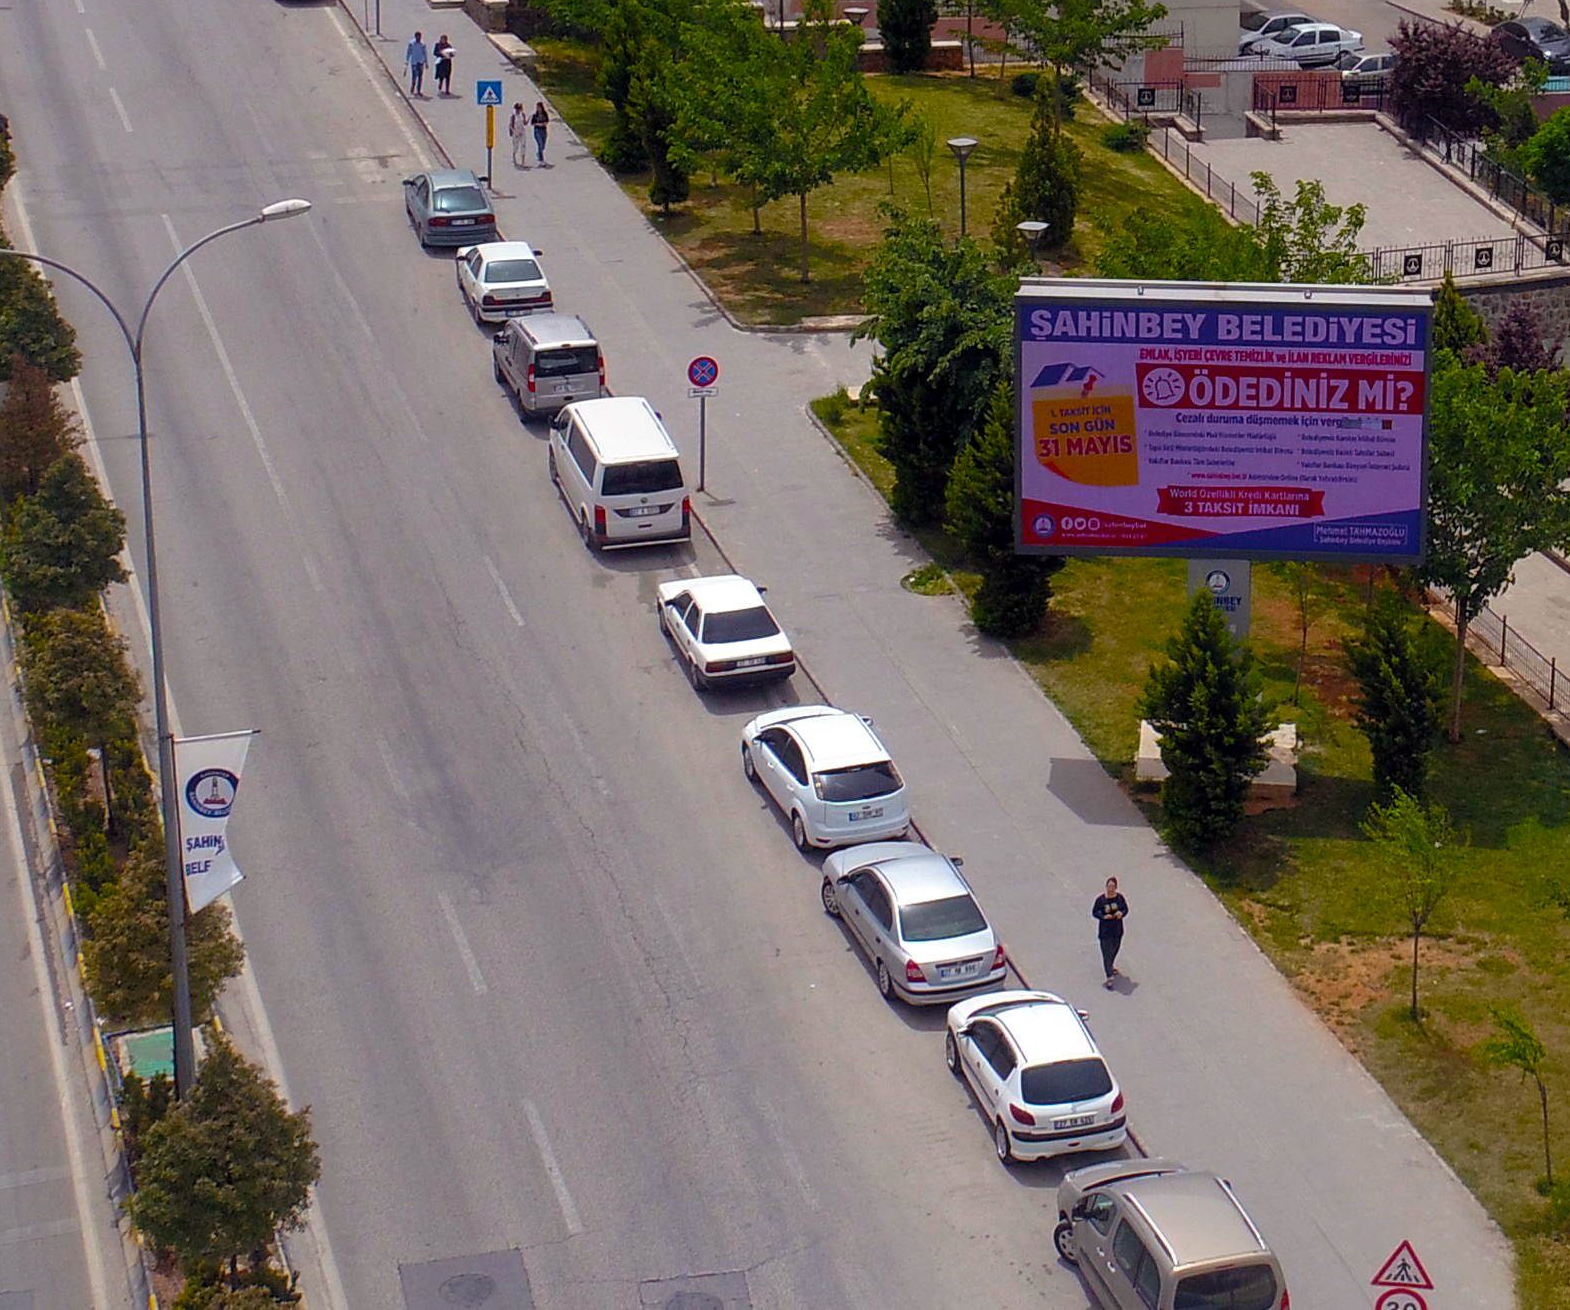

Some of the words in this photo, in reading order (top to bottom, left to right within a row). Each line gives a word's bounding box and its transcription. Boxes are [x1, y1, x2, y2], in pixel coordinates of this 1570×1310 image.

[1189, 368, 1349, 410] ÖDEDİNİZ
[1049, 421, 1080, 435] SON
[1084, 417, 1116, 432] GÜN
[1175, 412, 1205, 424] Cezalı
[1206, 413, 1244, 424] duruma
[1245, 414, 1298, 427] düşmemek
[1301, 415, 1321, 428] için
[1039, 437, 1061, 457] 31
[1066, 435, 1133, 456] MAYIS
[1169, 488, 1197, 499] World
[1184, 501, 1193, 514] 3
